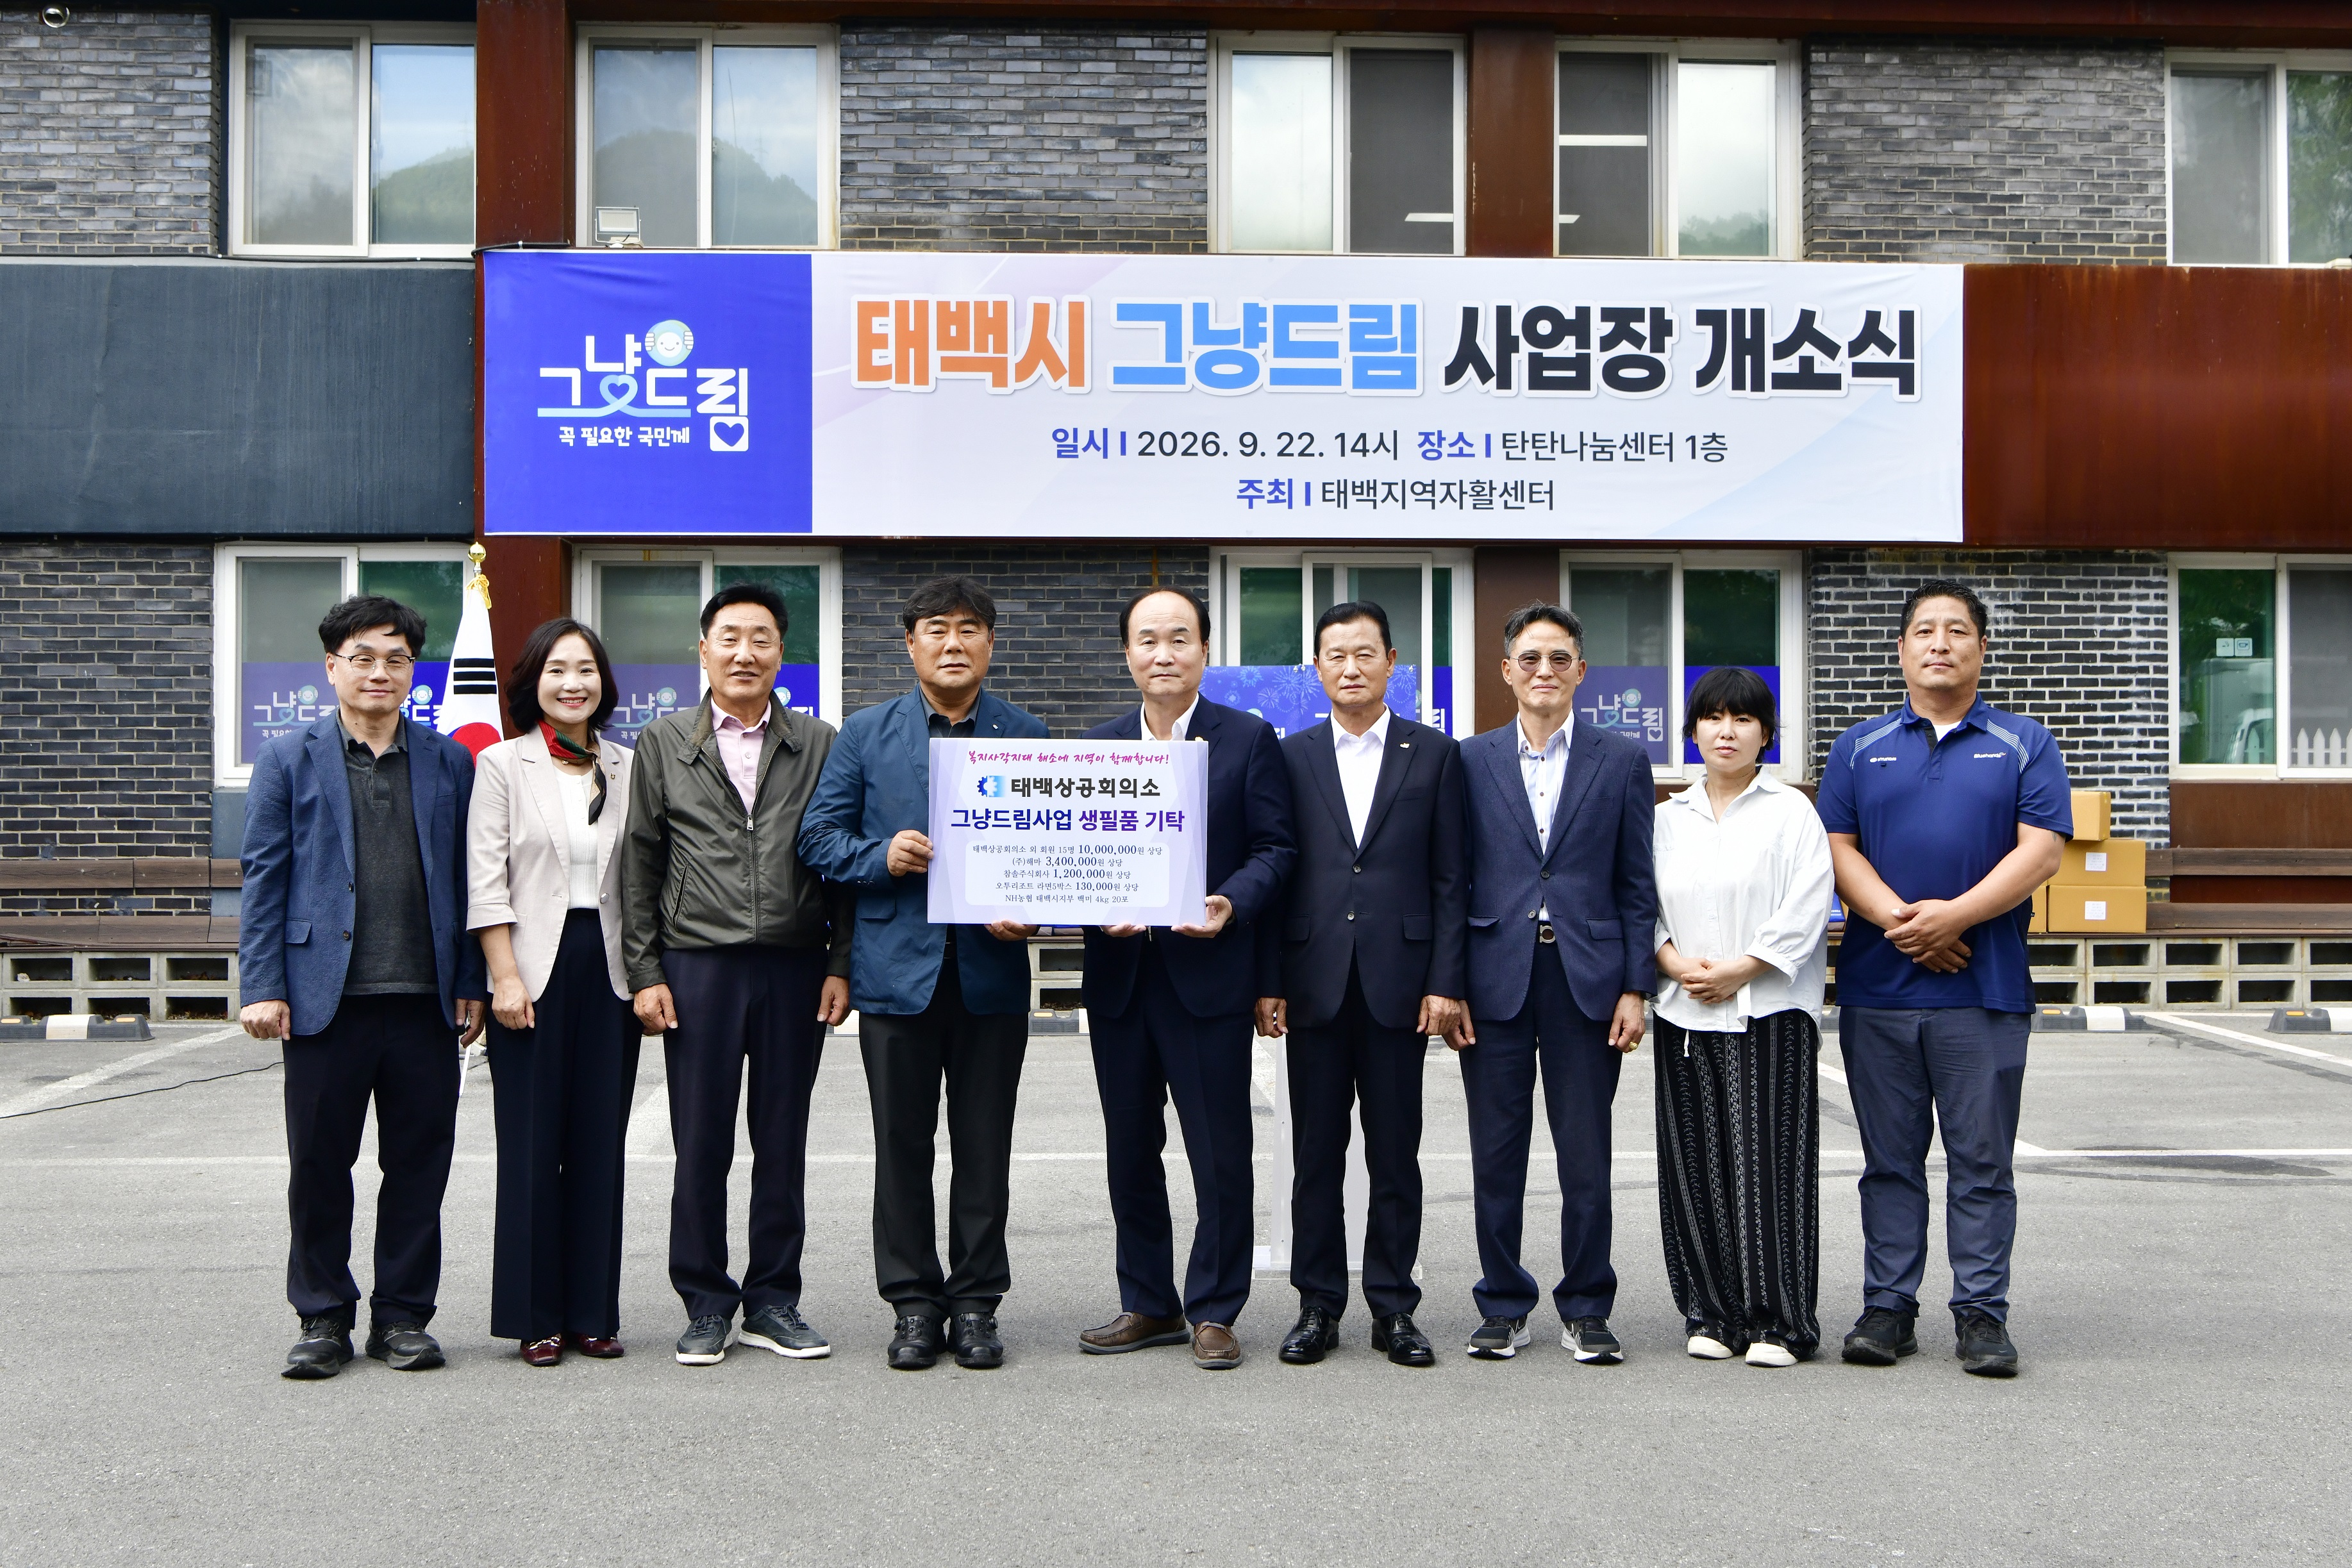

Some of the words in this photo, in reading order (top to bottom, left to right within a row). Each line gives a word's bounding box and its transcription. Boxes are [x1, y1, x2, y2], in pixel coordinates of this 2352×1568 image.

[858, 301, 1084, 387] 태백시
[1113, 303, 1416, 389] 그냥드림
[1445, 306, 1672, 392] 사업장
[1696, 308, 1914, 394] 개소식
[538, 320, 748, 451] 그냥드림
[560, 427, 575, 446] 꼭
[581, 427, 632, 446] 필요한
[638, 427, 689, 446] 국민께
[1053, 428, 1108, 459] 일시
[1138, 431, 1228, 456] 2026.
[1239, 432, 1265, 456] 9.
[1277, 432, 1324, 457] 22.
[1335, 430, 1397, 460] 14시
[1417, 430, 1475, 460] 장소
[1503, 431, 1672, 462] 탄탄나눔센터
[1686, 433, 1728, 462] 1층
[1237, 479, 1292, 509] 주최
[1322, 479, 1553, 510] 태백지역자활센터
[621, 731, 628, 740] 꼭
[969, 751, 1033, 764] 복지사각지대
[1037, 753, 1069, 763] 해소에
[1074, 753, 1105, 765] 지역이
[1110, 753, 1169, 765] 함께합니다!
[1012, 778, 1160, 798] 태백상공회의소
[951, 808, 1071, 830] 그냥드림사업
[1079, 810, 1138, 831] 생필품
[1146, 810, 1185, 831] 기탁
[973, 845, 1026, 853] 태백상공회의소
[1040, 846, 1055, 854] 회원
[1079, 845, 1144, 855] 10,000,000원
[1147, 847, 1162, 855] 상당
[1046, 856, 1104, 867] 3,400,000원
[1004, 870, 1049, 878] 참솔주식회사
[1054, 869, 1112, 880] 1,200,000원
[1037, 882, 1072, 890] 라면5박스
[1076, 882, 1120, 891] 130,000원
[1037, 894, 1074, 903] 태백시지부
[1078, 895, 1091, 903] 백미
